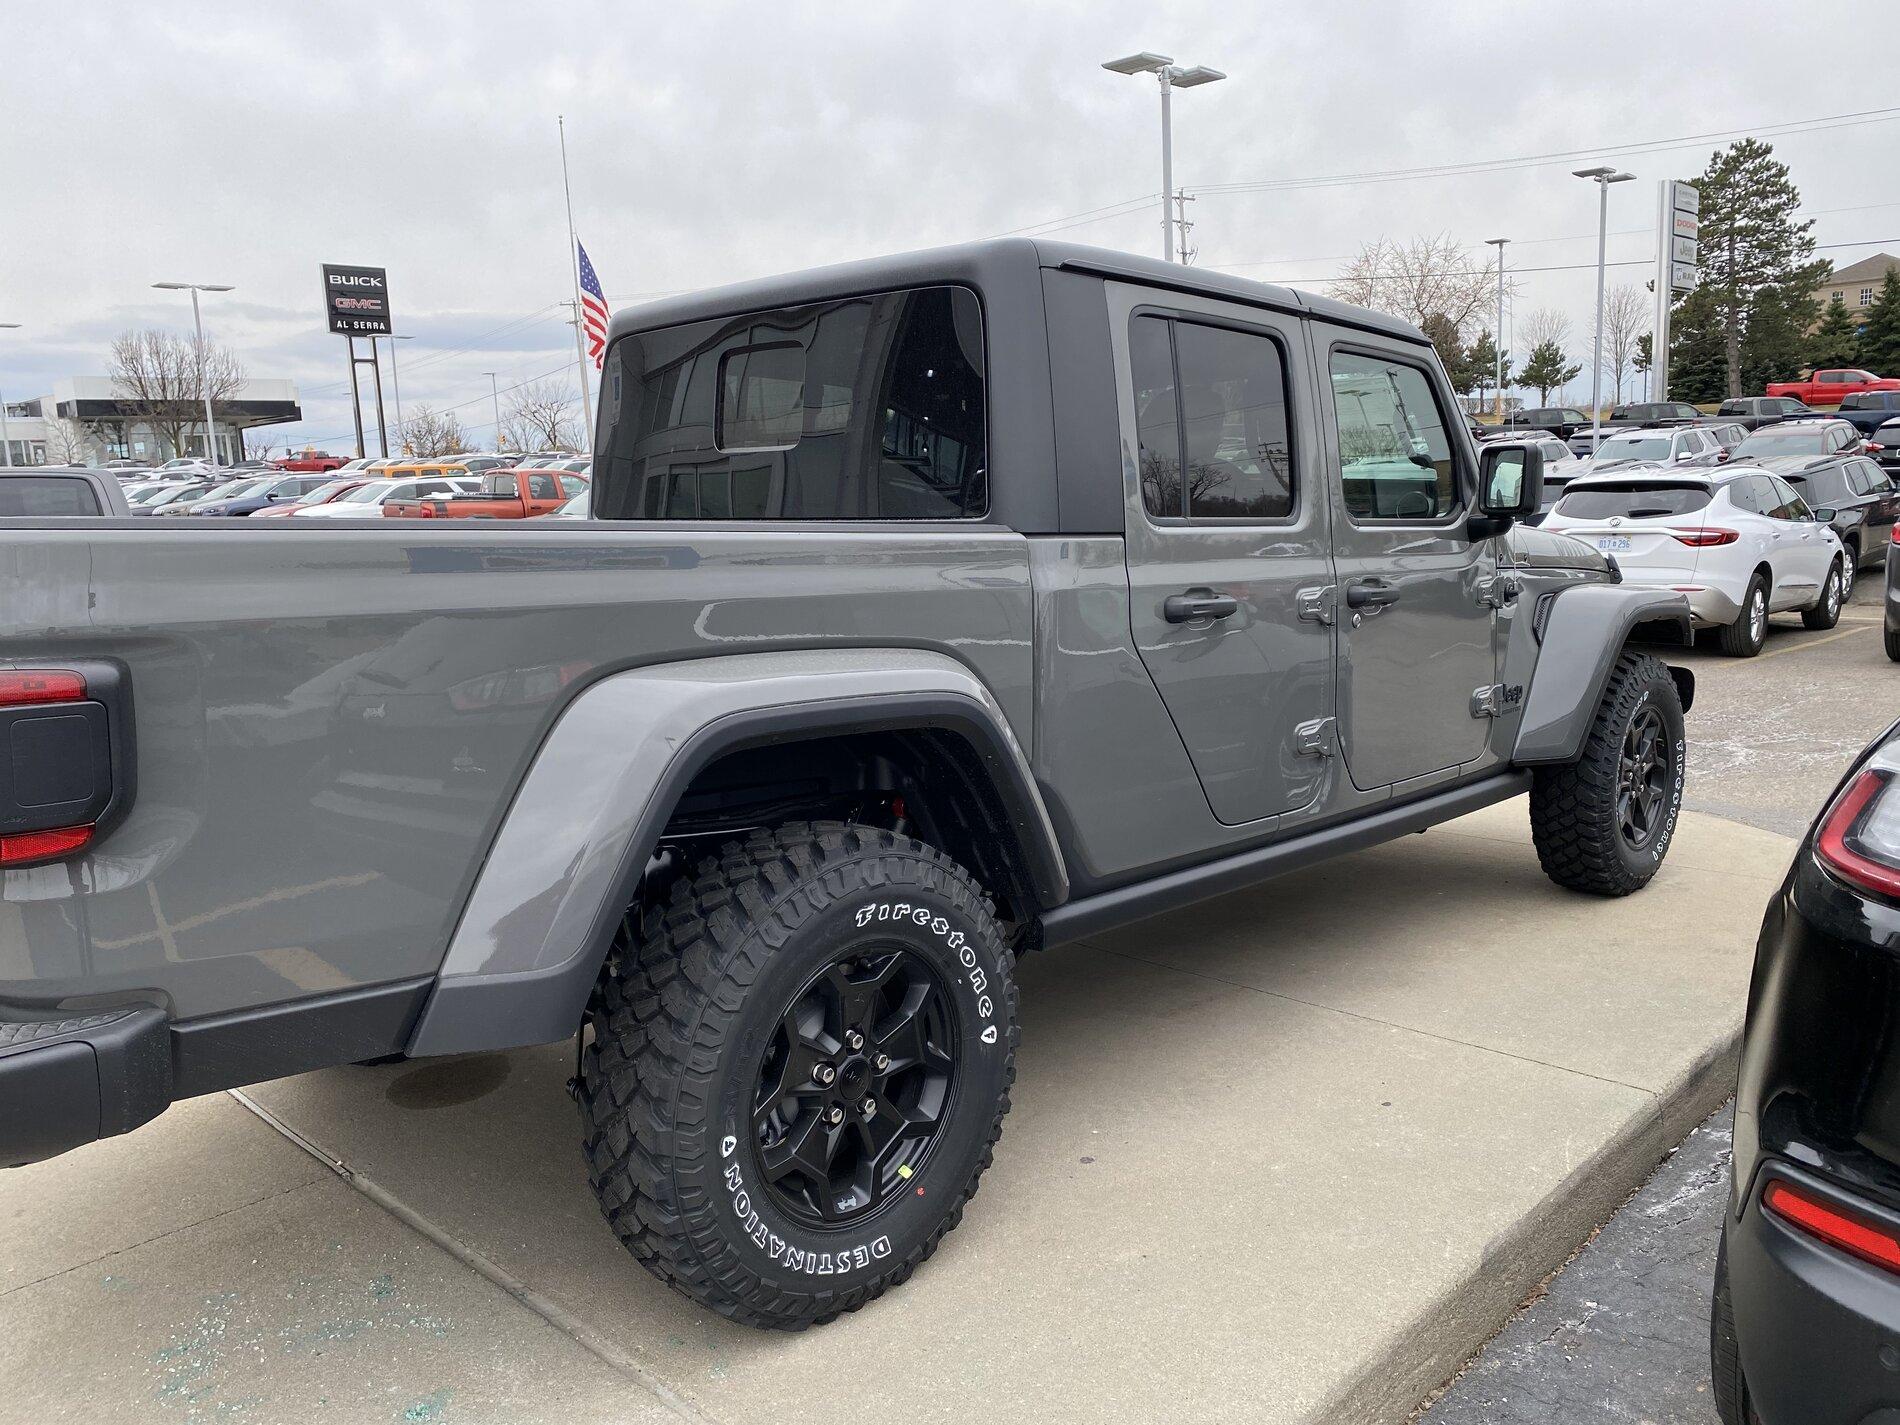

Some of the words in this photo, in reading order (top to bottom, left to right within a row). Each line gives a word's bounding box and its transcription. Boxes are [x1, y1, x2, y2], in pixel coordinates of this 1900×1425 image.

[329, 275, 383, 287] BUICK
[335, 297, 382, 310] GMC
[337, 320, 349, 329] AL
[353, 321, 386, 330] SERRA
[855, 903, 995, 1019] Firestone
[723, 1162, 893, 1275] DESTINATION
